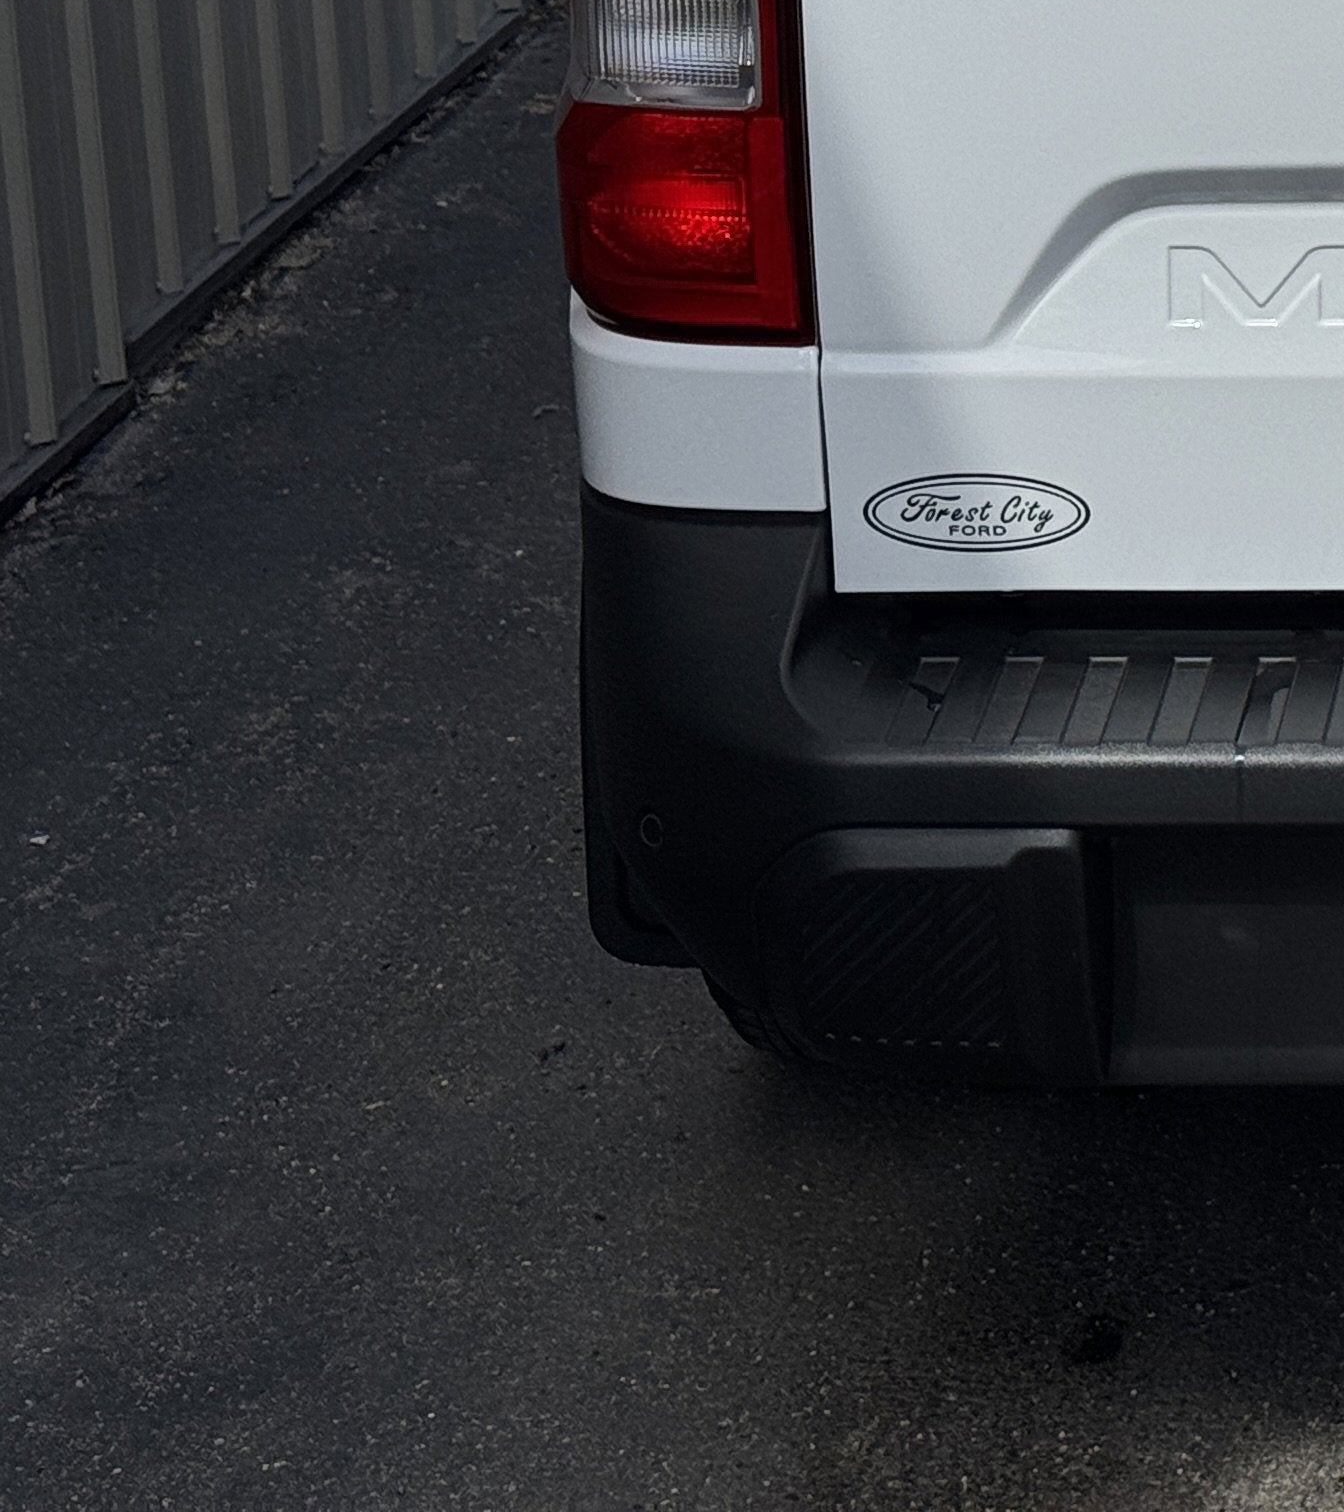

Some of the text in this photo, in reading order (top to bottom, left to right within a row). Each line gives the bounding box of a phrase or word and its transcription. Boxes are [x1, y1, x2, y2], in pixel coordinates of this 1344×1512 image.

[900, 493, 1054, 533] Forest City
[948, 525, 1007, 537] FORD
